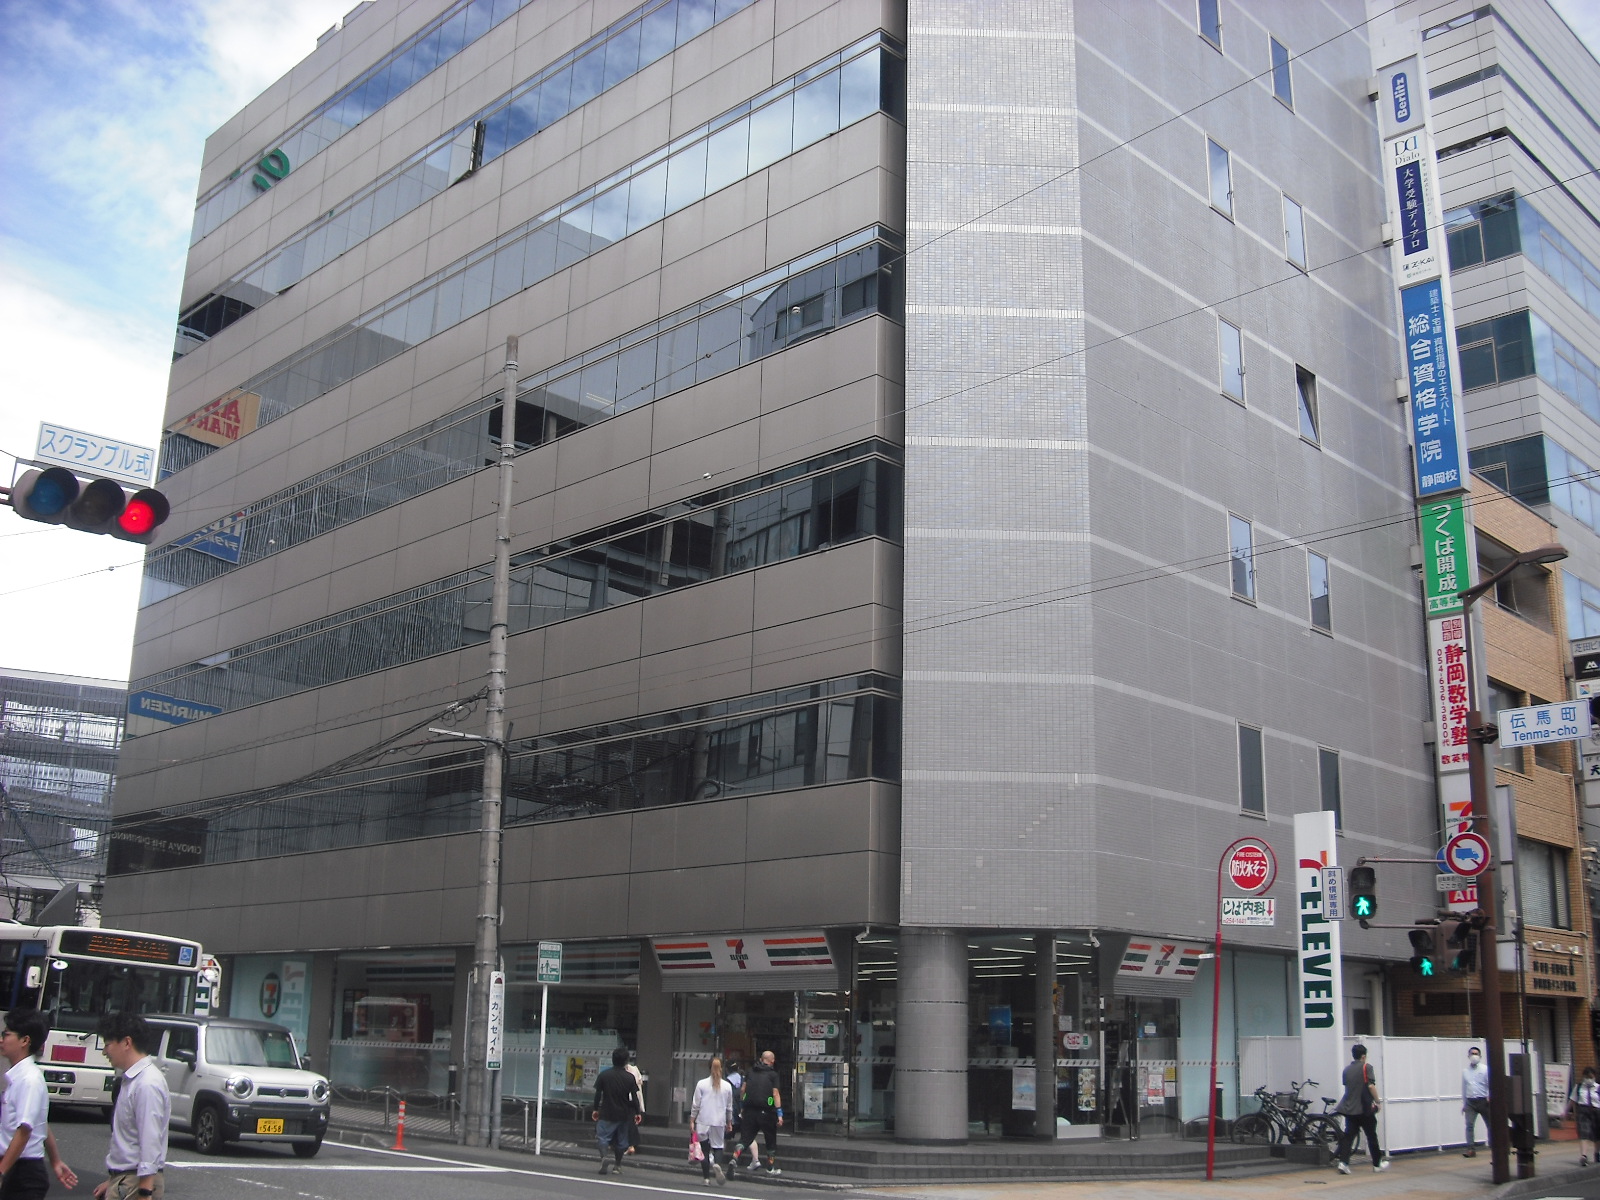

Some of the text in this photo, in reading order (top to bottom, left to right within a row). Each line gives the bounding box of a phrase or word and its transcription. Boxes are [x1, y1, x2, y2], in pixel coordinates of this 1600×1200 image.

[1394, 77, 1408, 118] Berlitz
[1395, 152, 1420, 165] Dialo
[1403, 168, 1420, 248] 大学受験ディアロ
[1408, 313, 1443, 464] 総合資格学院
[41, 430, 150, 475] スクランブル式
[1422, 469, 1458, 488] 静岡校
[1431, 504, 1457, 593] つくば開成
[1429, 596, 1464, 609] 高等学
[1574, 641, 1600, 653] 芝田ビ
[1444, 643, 1469, 747] 静岡数学塾
[1510, 706, 1577, 729] 伝馬町
[1512, 725, 1578, 742] Tenma-cho
[1231, 860, 1267, 877] 防火水そう
[1327, 870, 1338, 917] 斜め横断専用
[490, 1001, 499, 1046] カンセイ
